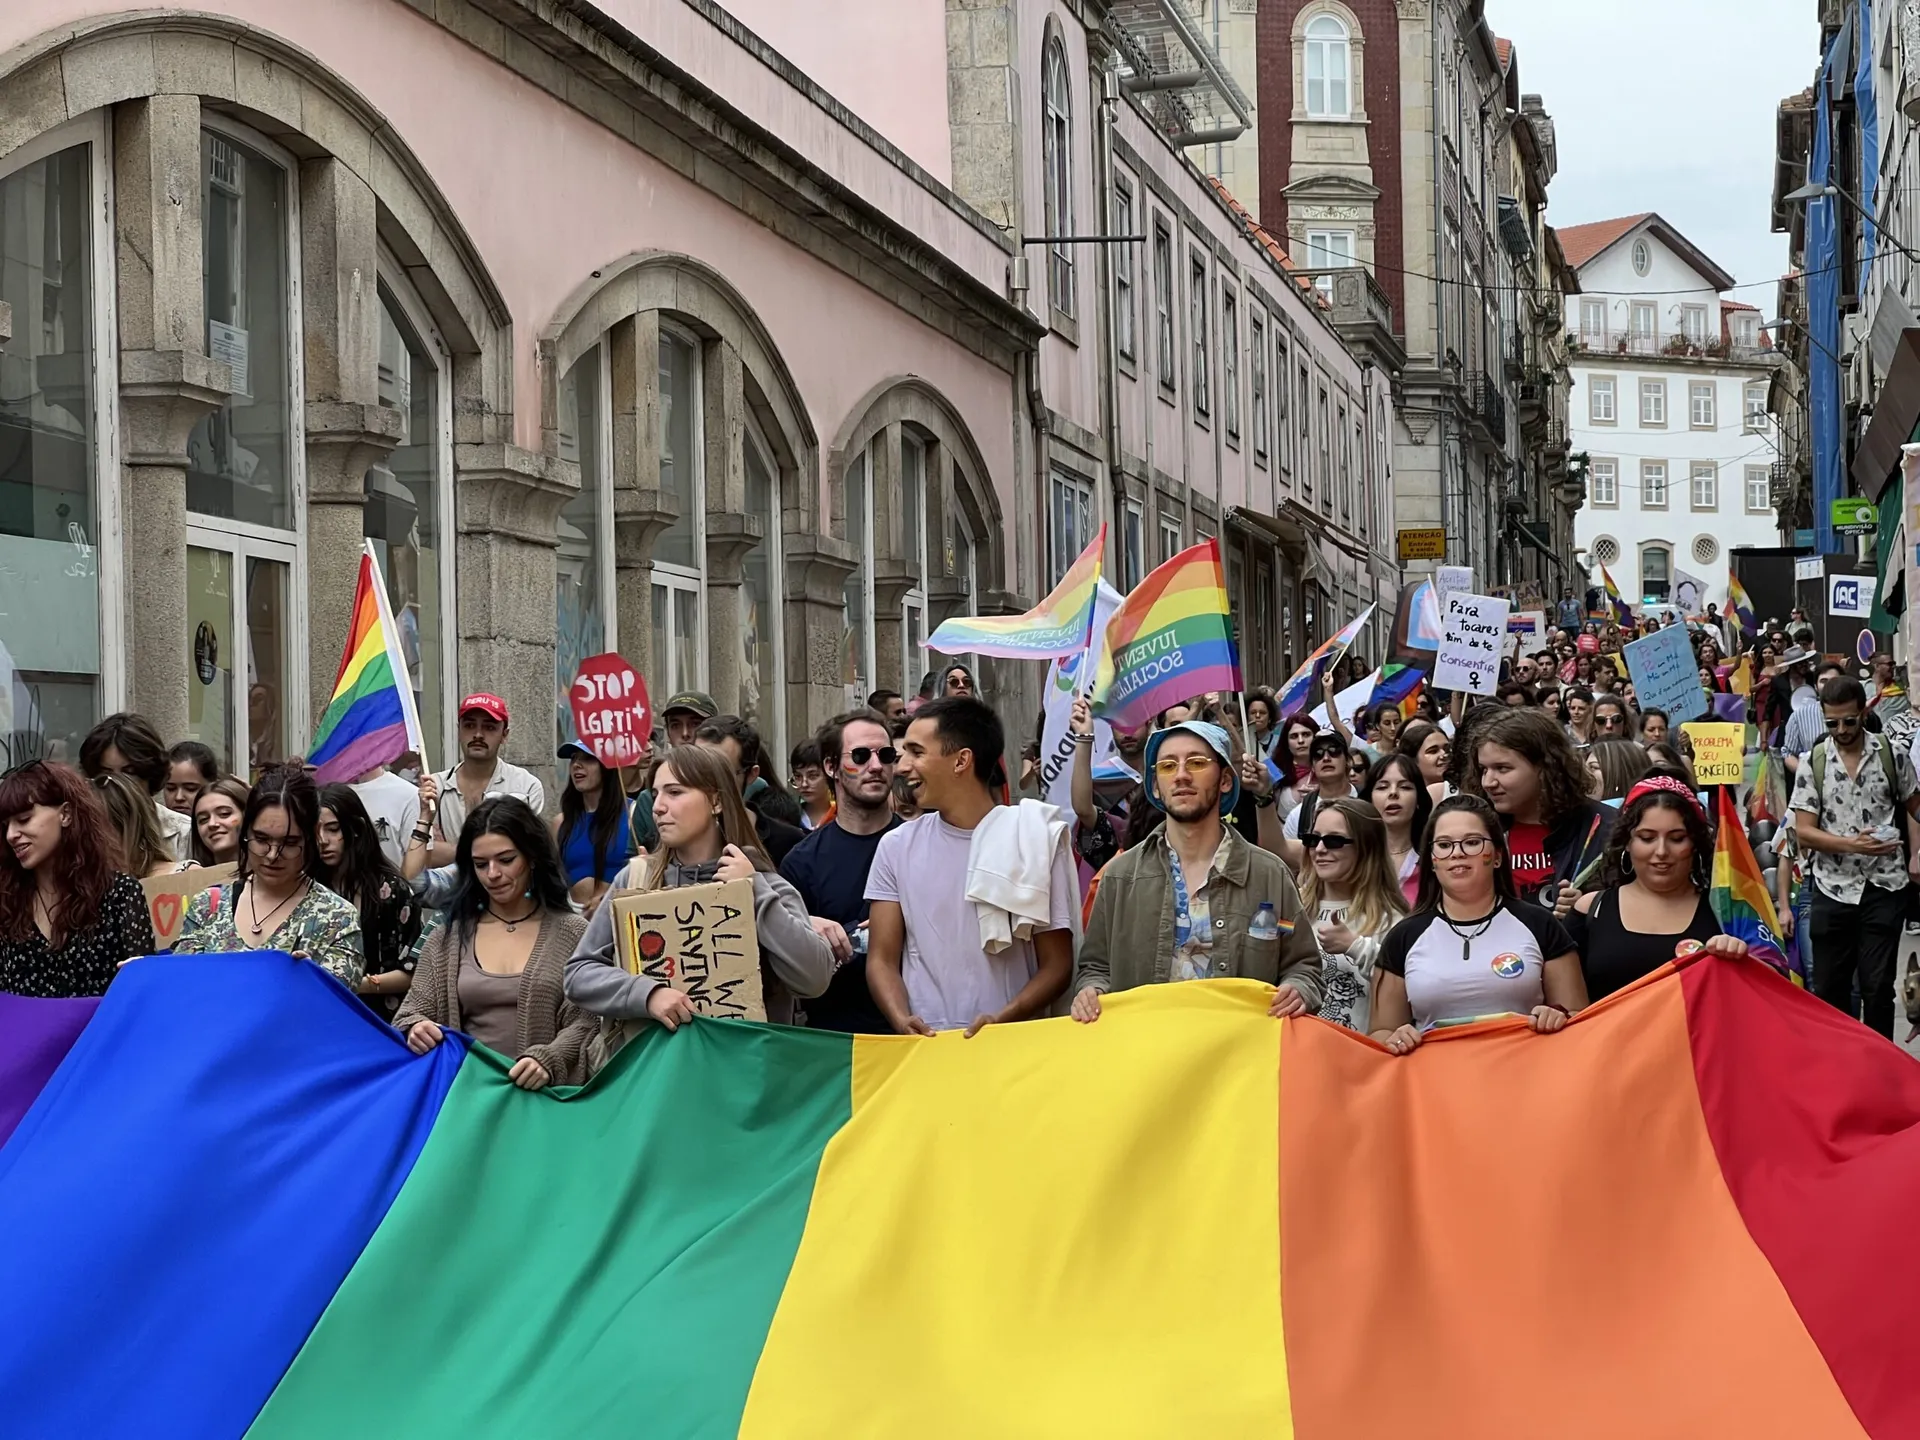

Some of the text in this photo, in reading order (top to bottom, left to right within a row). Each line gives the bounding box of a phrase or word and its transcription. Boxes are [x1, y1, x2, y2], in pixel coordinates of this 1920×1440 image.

[1450, 600, 1479, 618] Para
[1459, 618, 1499, 637] tocares
[575, 669, 635, 703] STOP
[465, 696, 489, 706] PERU
[1693, 737, 1734, 748] PROBLEMA
[1700, 751, 1719, 761] SEU
[710, 904, 744, 969] ALL
